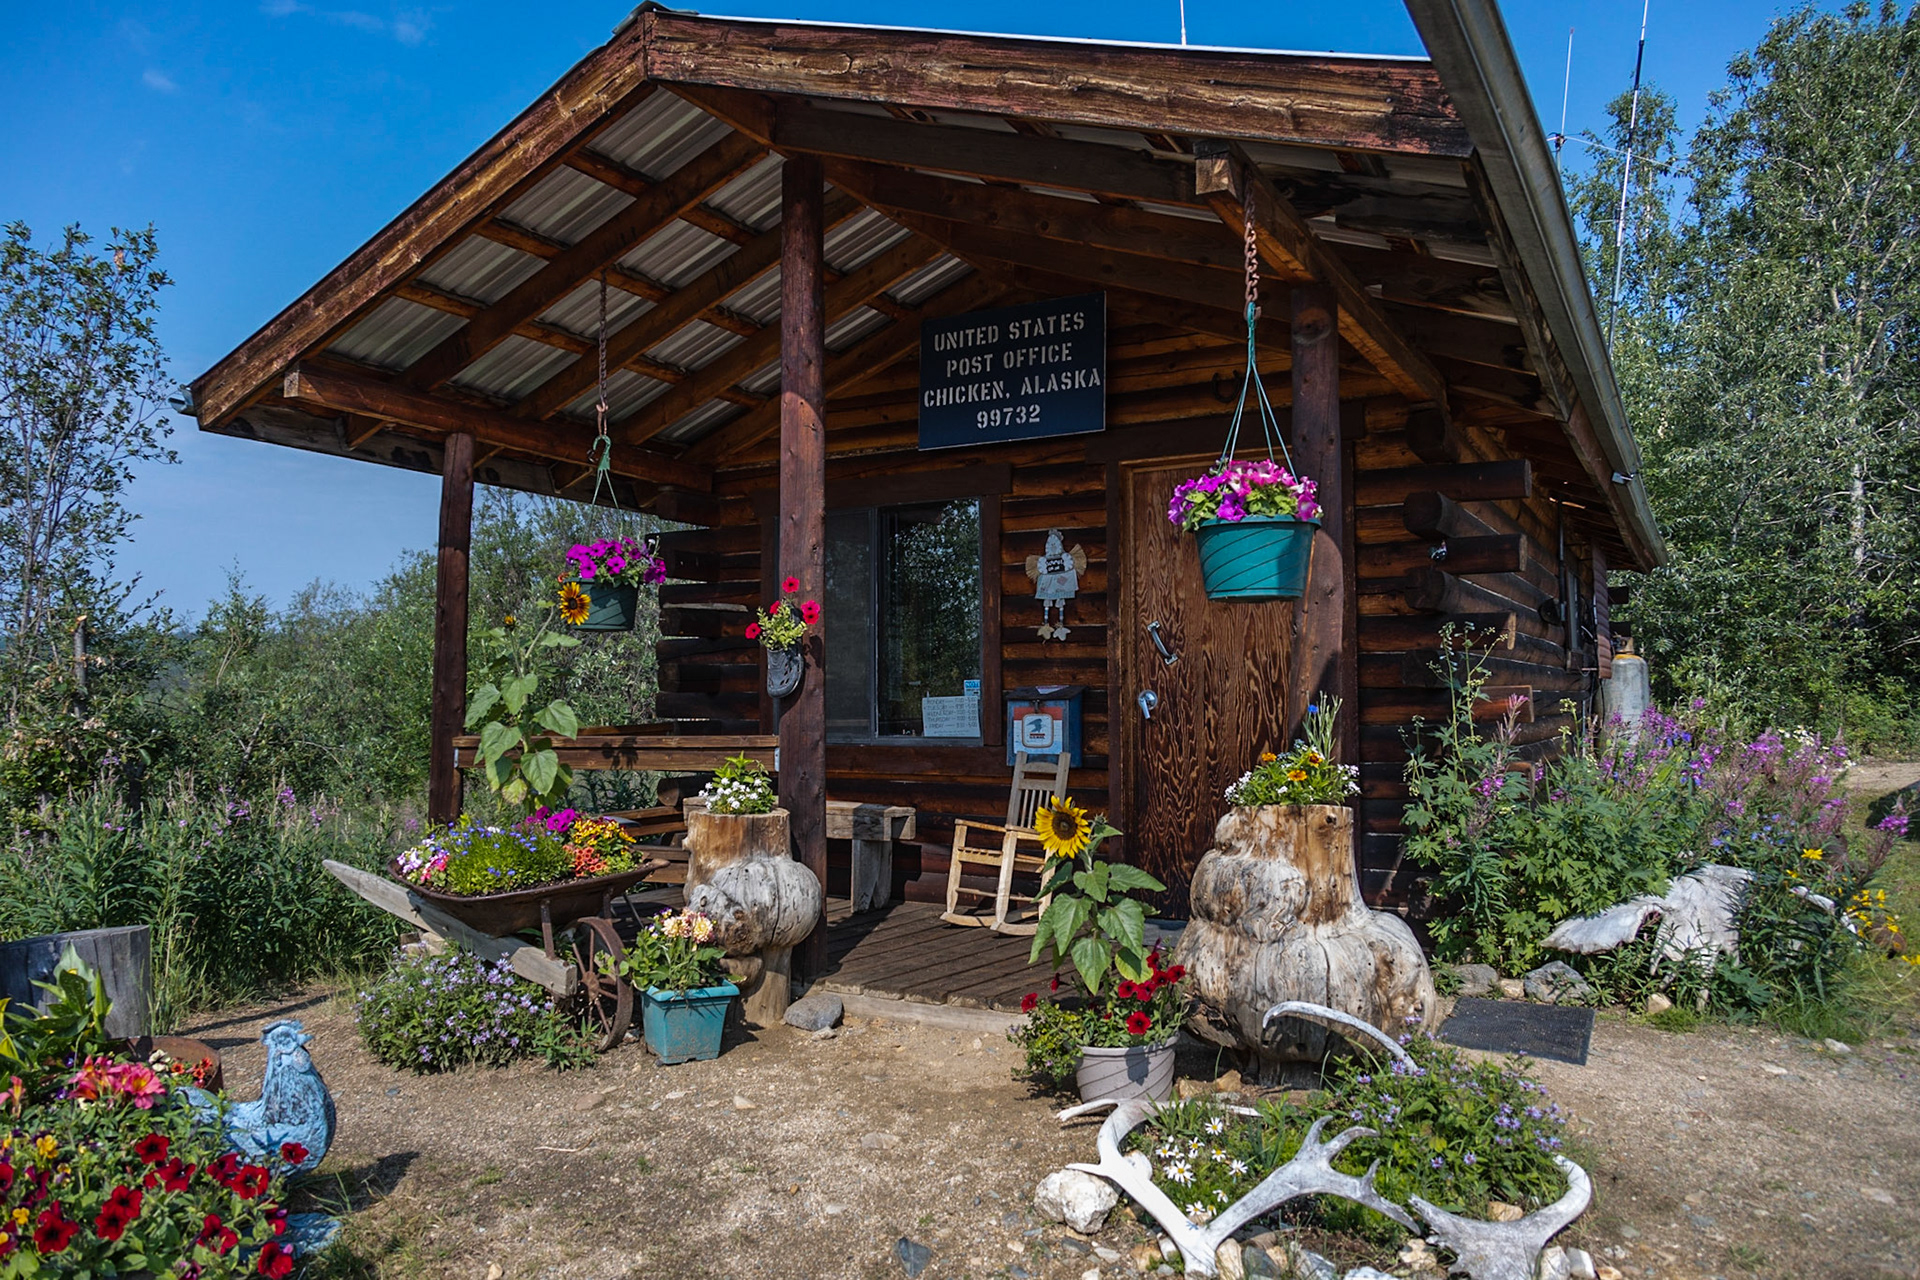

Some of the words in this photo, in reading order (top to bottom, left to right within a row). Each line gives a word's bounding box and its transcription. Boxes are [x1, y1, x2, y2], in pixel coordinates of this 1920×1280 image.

[934, 325, 999, 352] UNITED
[1009, 311, 1085, 340] STATES
[946, 353, 994, 378] POST
[1003, 342, 1073, 369] OFFICE
[923, 380, 1010, 408] CHICKEN,
[1021, 367, 1101, 396] ALASKA
[976, 404, 1041, 429] 99732
